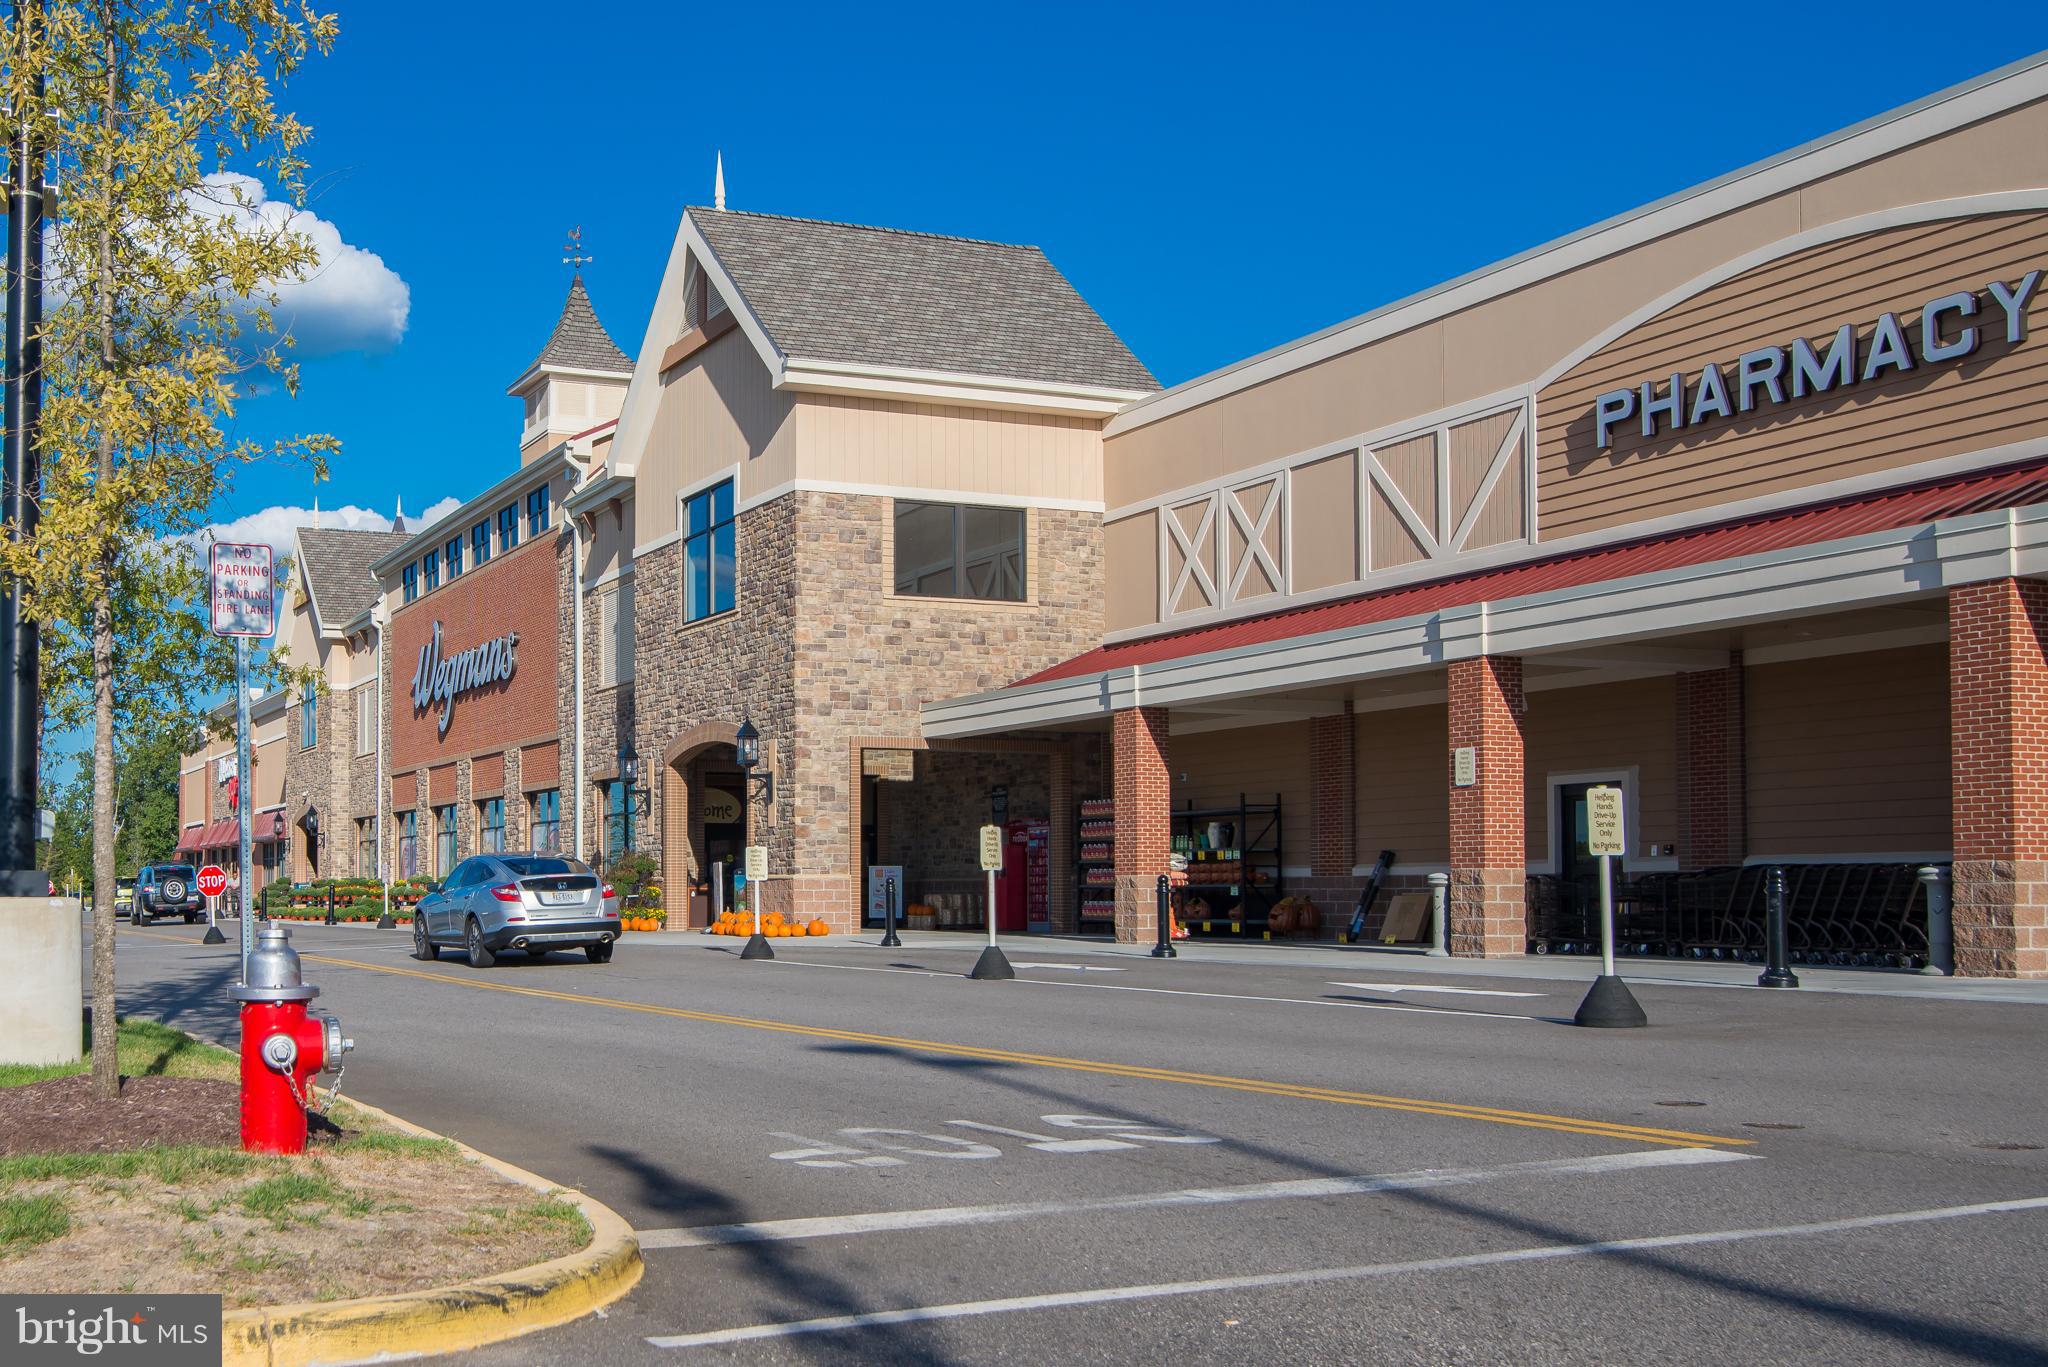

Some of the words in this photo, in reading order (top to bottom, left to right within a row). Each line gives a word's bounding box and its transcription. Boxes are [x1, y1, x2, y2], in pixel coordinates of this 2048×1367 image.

[1596, 270, 2046, 447] PHARMACY
[234, 548, 252, 559] NO
[217, 564, 269, 577] PARKING
[237, 579, 249, 587] OR
[217, 589, 269, 601] STANDING
[217, 603, 239, 614] FIRE
[245, 604, 270, 615] LANE
[411, 620, 519, 733] Wegmans
[1594, 793, 1615, 802] Helping
[1594, 811, 1617, 820] Drive-Up
[1595, 820, 1616, 828] Service
[1599, 829, 1613, 838] Only
[1600, 841, 1621, 851] Parking
[199, 874, 225, 888] STOP
